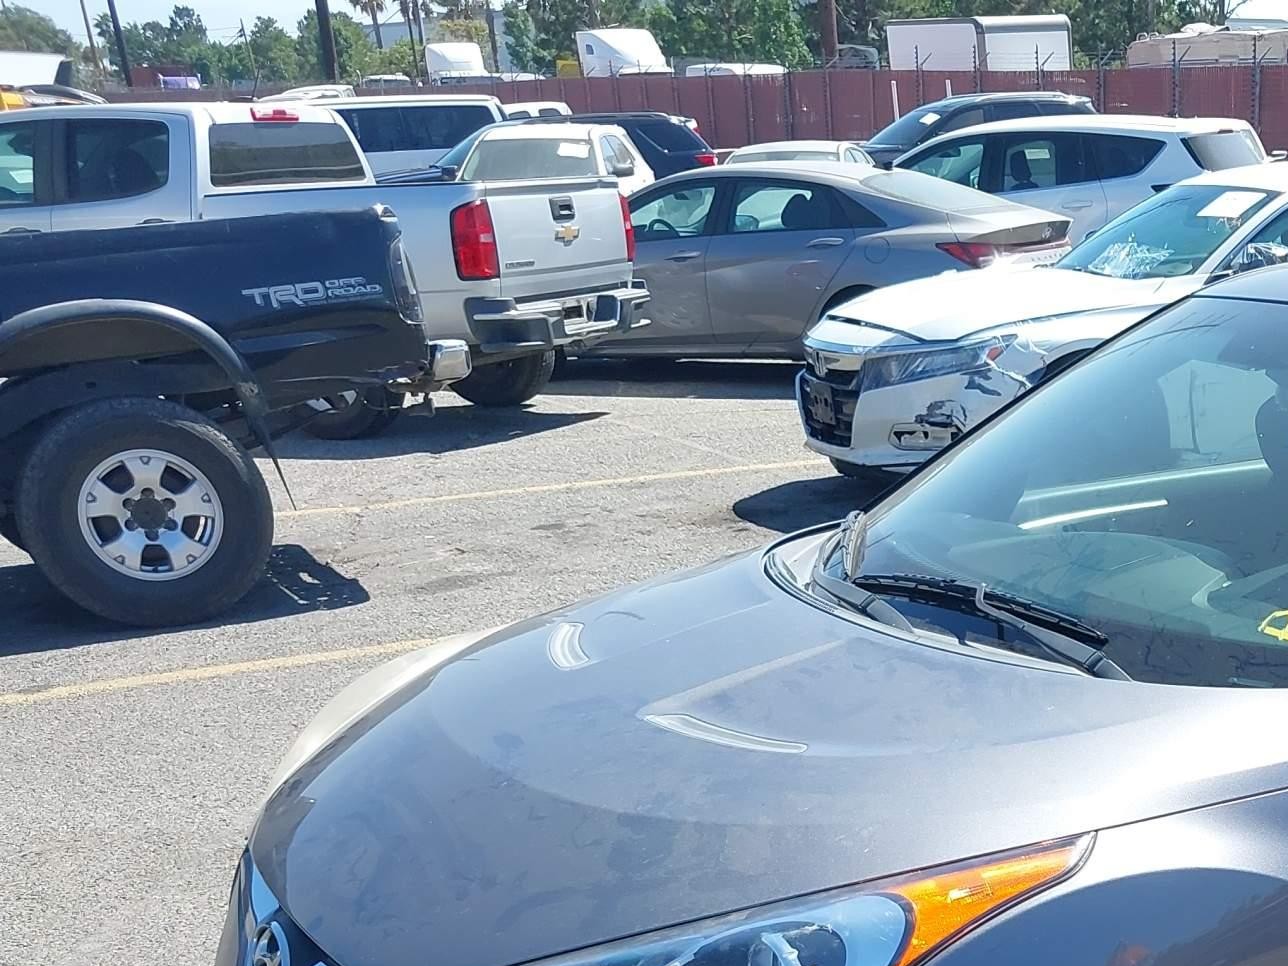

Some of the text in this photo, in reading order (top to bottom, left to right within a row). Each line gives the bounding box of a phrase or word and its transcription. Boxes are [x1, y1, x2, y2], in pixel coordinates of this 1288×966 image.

[326, 276, 366, 288] OFF
[242, 281, 326, 308] TRD
[327, 284, 383, 298] ROAD
